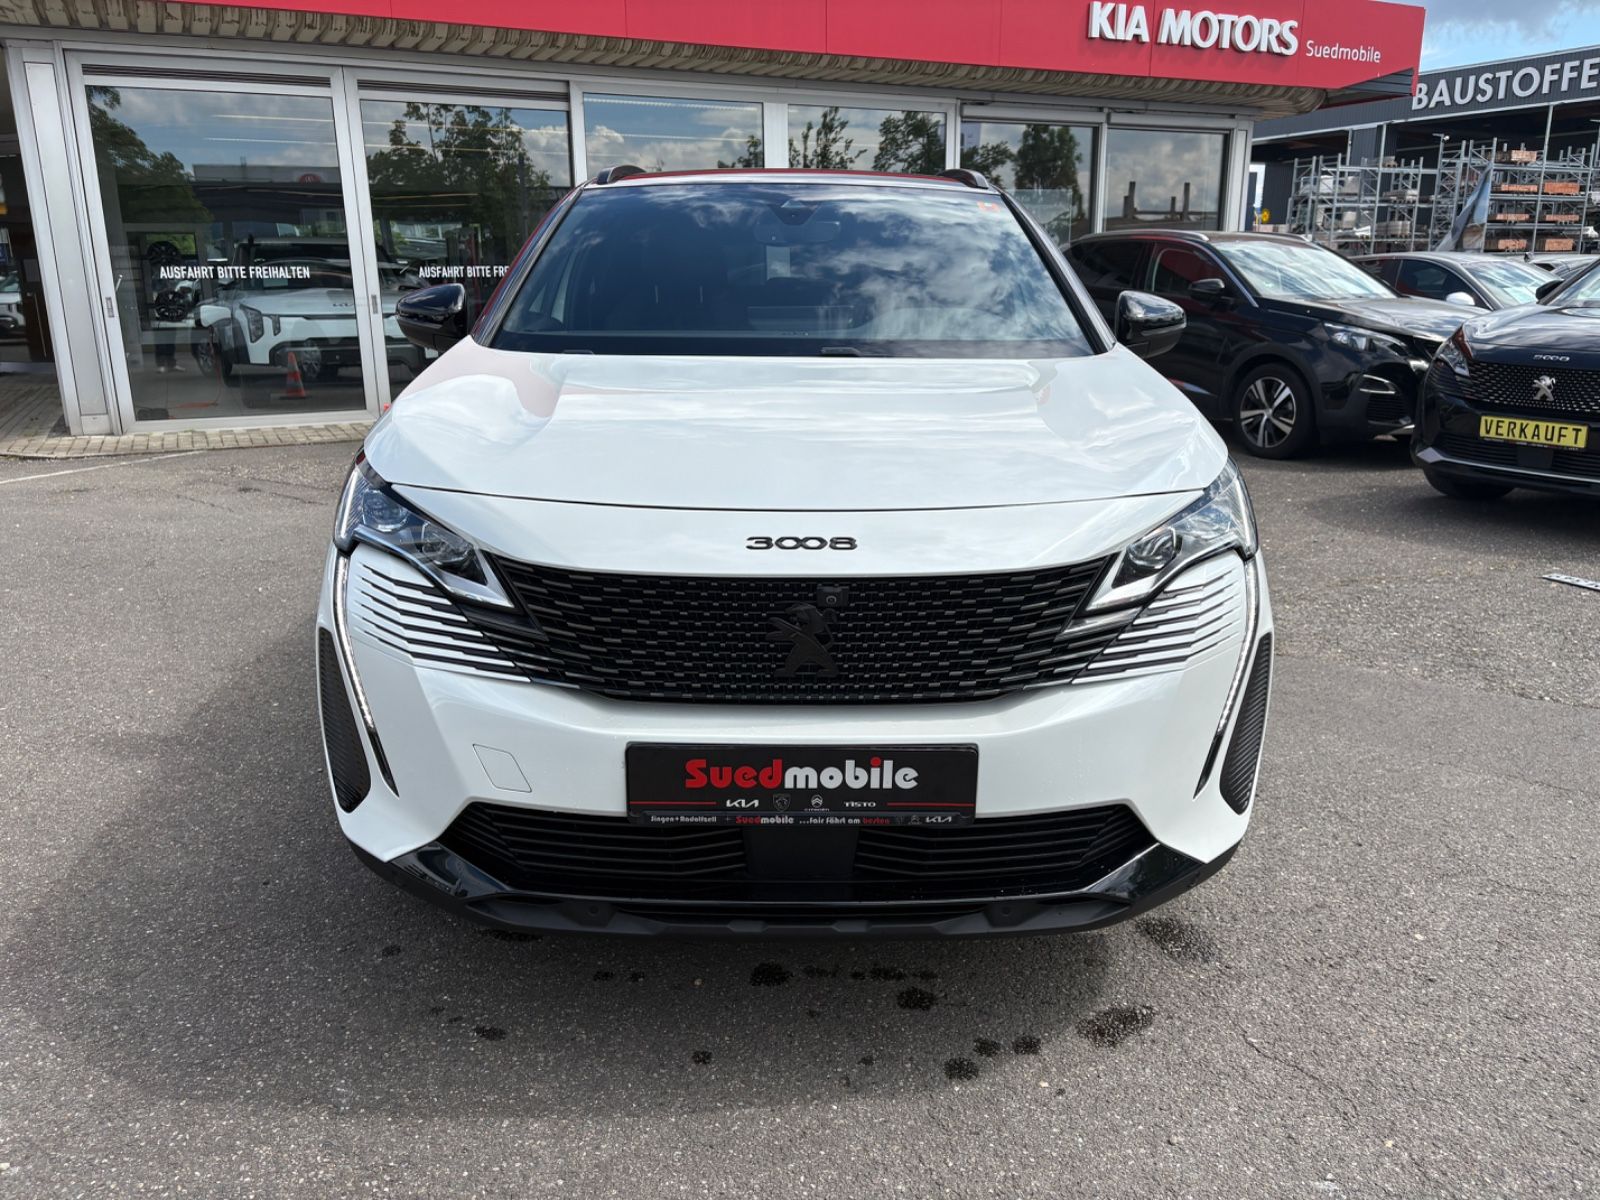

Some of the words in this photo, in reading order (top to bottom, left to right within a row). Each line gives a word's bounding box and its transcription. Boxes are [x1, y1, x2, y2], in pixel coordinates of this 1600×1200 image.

[1088, 1, 1149, 42] KIA
[1157, 8, 1298, 56] MOTORS
[1306, 40, 1381, 63] Suedmobile
[1411, 57, 1600, 110] BAUSTOFFE
[160, 265, 214, 279] AUSFAHRT
[217, 265, 247, 279] BITTE
[250, 265, 311, 279] FREIHALTEN
[419, 265, 464, 278] AUSFAHRT
[466, 265, 491, 278] BITTE
[1484, 418, 1582, 445] VERKAUFT
[745, 536, 858, 550] 3008
[685, 757, 918, 789] Suedmobile
[726, 799, 759, 808] KIA
[735, 815, 794, 824] Suedmobile
